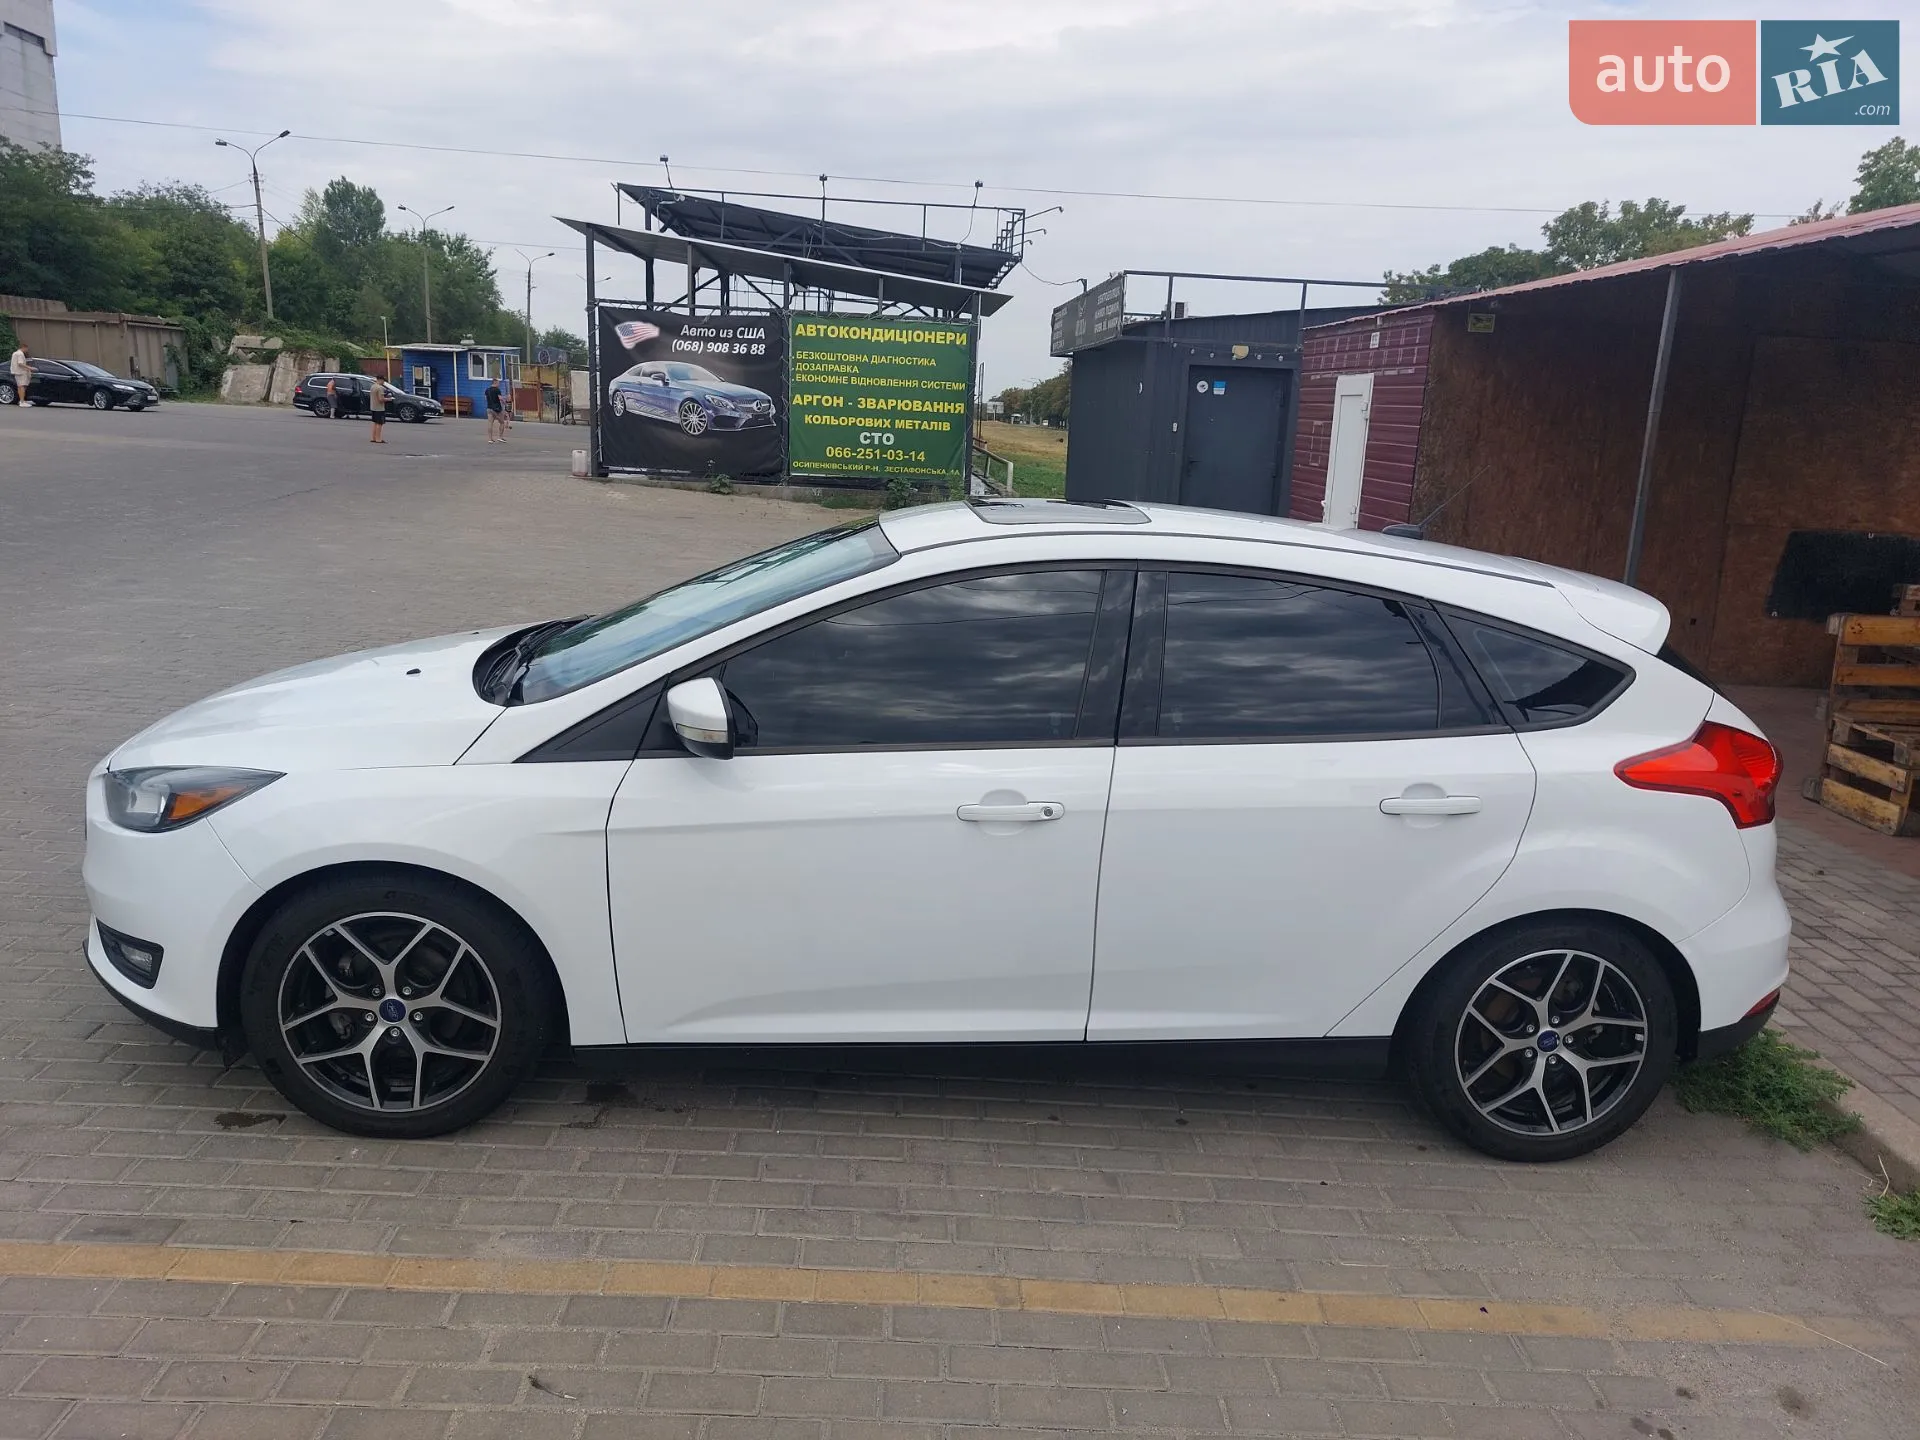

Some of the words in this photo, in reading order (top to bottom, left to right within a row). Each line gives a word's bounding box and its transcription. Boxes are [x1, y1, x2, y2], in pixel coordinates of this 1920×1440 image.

[680, 324, 716, 337] Авто
[719, 328, 734, 338] из
[736, 327, 766, 340] США
[795, 323, 967, 345] АВТОКОНДИЦІОНЕРИ
[671, 339, 704, 354] (068)
[706, 341, 730, 354] 908
[731, 342, 748, 355] 36
[749, 343, 766, 356] 88
[796, 350, 869, 363] БЕЗКОШТОВНА
[870, 353, 937, 367] ДІАГНОСТИКА
[795, 362, 860, 374] ДОЗАПРАВКА
[795, 373, 849, 385] ЕКОНОМНЕ
[850, 376, 920, 389] ВІДНОВЛЕННЯ
[920, 380, 967, 391] СИСТЕМИ
[792, 393, 844, 408] АРГОН
[857, 397, 966, 414] ЗВАРЮВАННЯ
[804, 414, 892, 429] КОЛЬОРОВИХ
[894, 419, 952, 432] МЕТАЛІВ
[859, 431, 896, 446] СТО
[826, 447, 926, 462] 066-251-03-14
